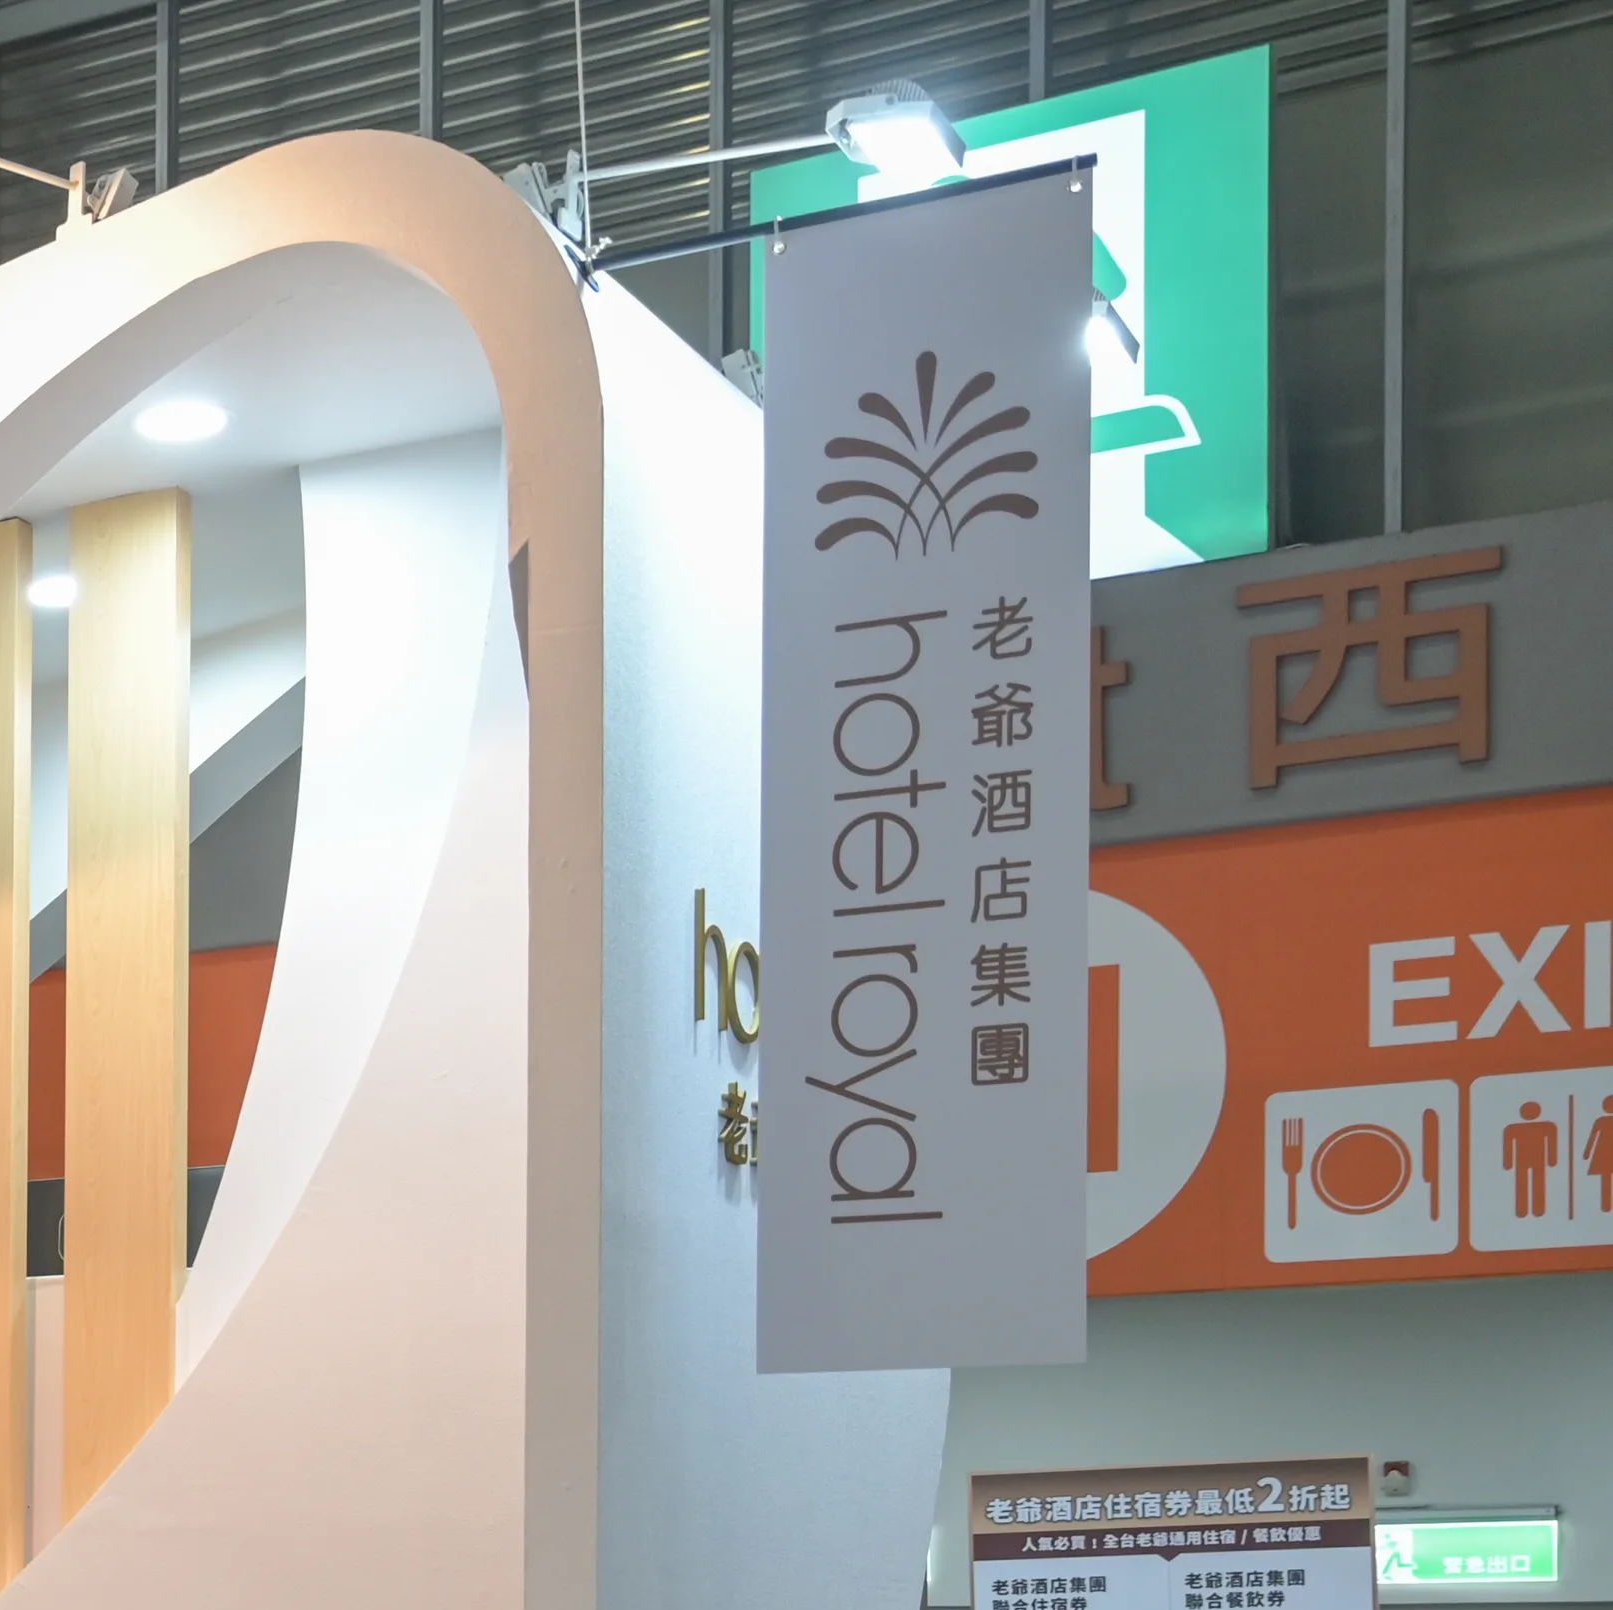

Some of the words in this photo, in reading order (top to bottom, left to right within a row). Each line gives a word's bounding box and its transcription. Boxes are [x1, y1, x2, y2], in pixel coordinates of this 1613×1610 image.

[1237, 546, 1502, 790] 西
[832, 609, 948, 917] hotel
[970, 596, 1034, 1087] 老爺酒店集團
[804, 942, 944, 1225] royal
[985, 1476, 1351, 1525] 老爺酒店住宿券最低2折起
[991, 1575, 1108, 1596] 老爺酒店集團
[1184, 1568, 1306, 1590] 老爺酒店集團
[1184, 1591, 1285, 1610] 聯合餐飲券
